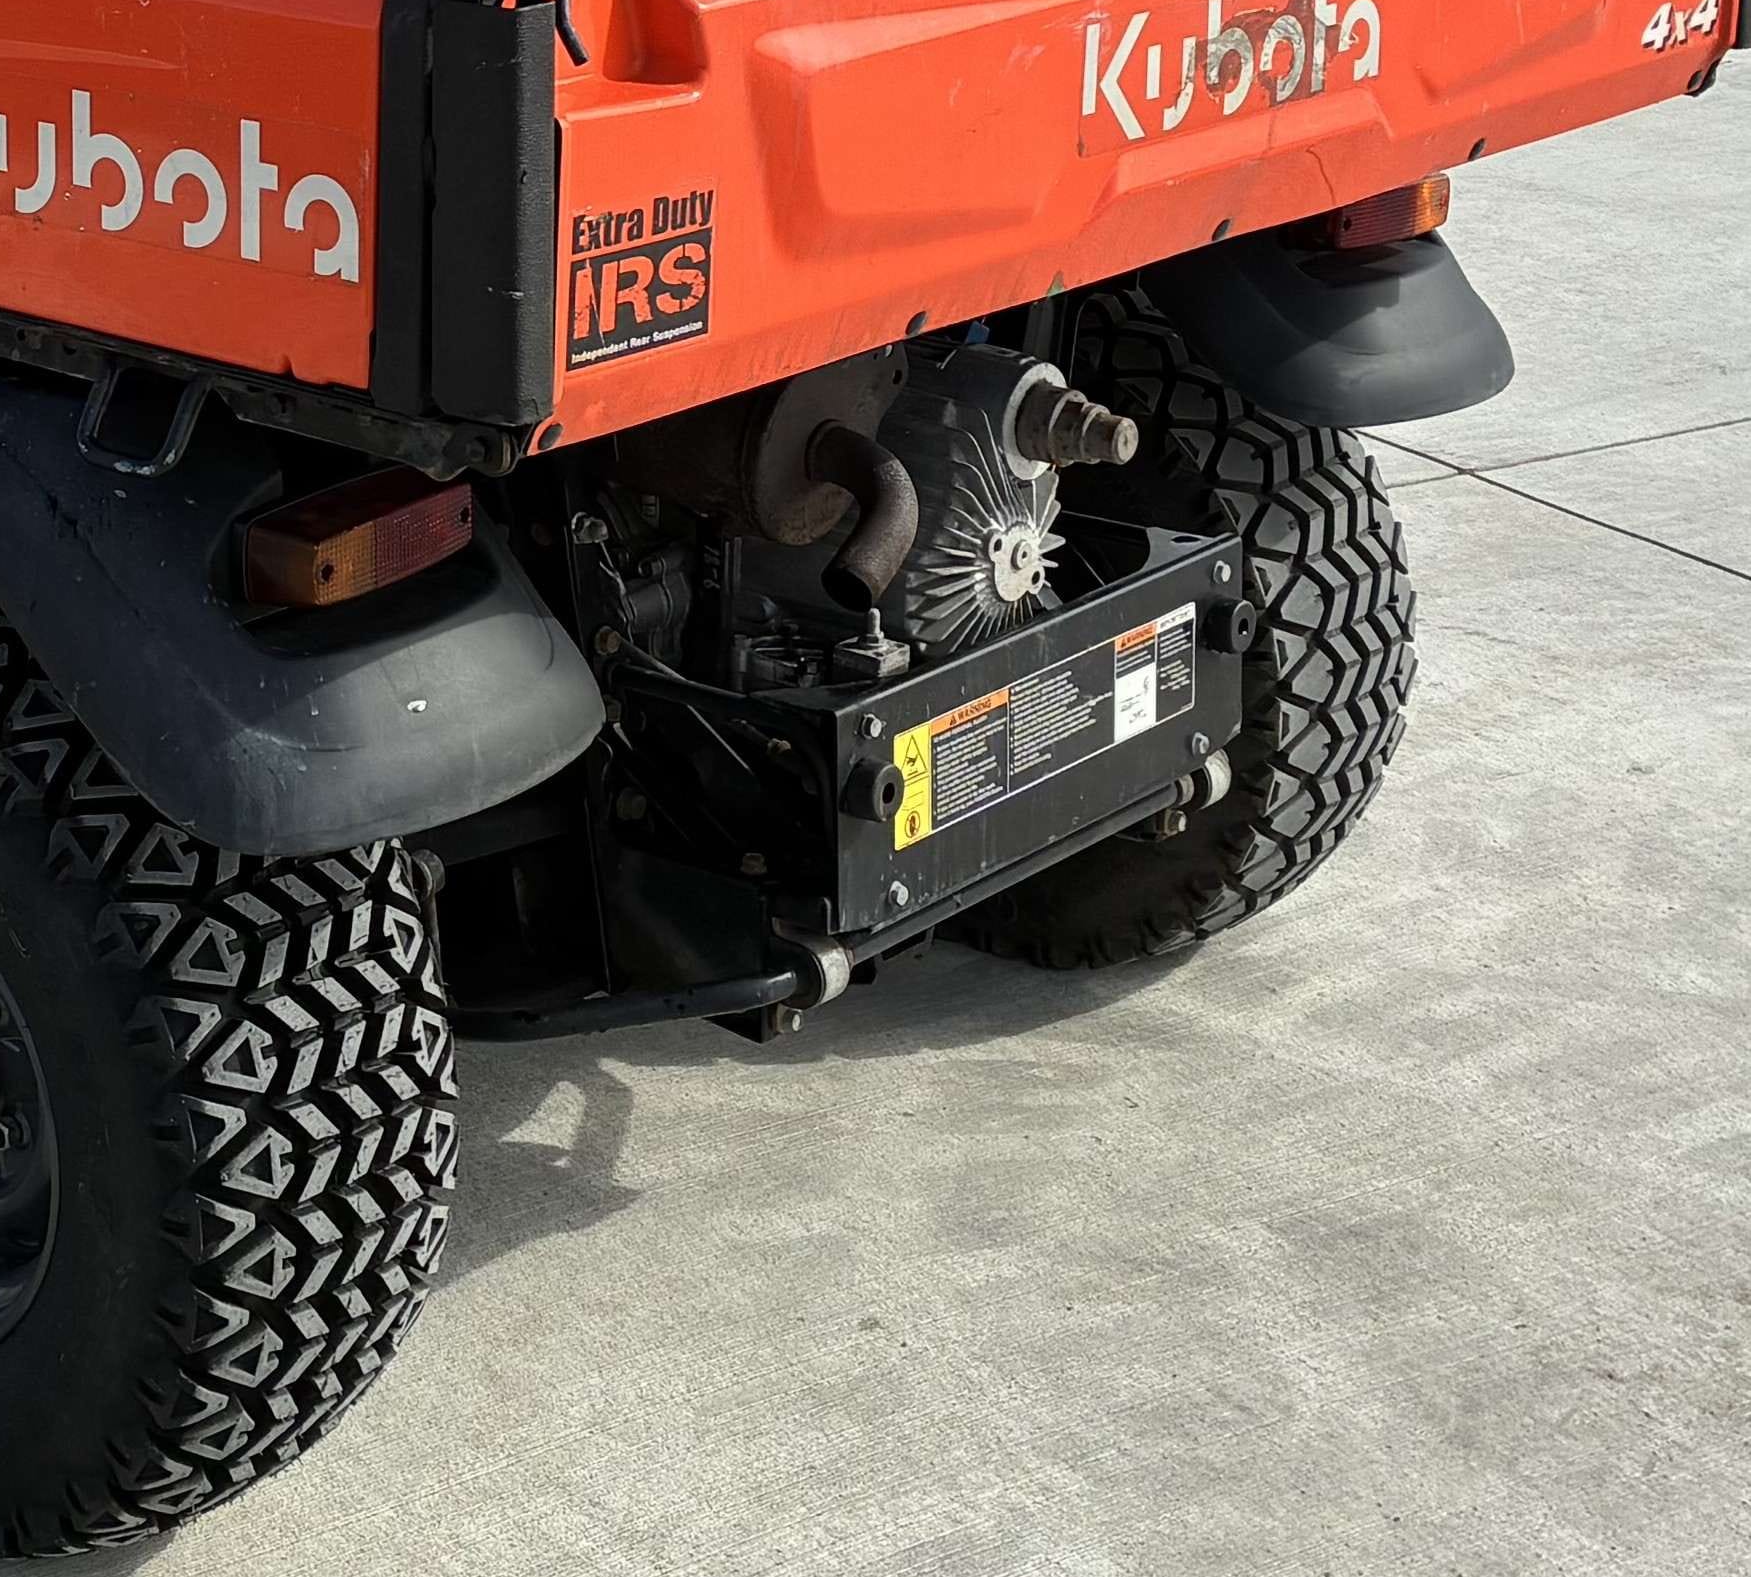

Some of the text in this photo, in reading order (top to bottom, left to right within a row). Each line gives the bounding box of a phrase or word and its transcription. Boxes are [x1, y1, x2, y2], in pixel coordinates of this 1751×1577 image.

[572, 189, 714, 255] Extra Duty
[573, 242, 707, 341] IRS
[571, 320, 704, 364] Independent Rear Suspension
